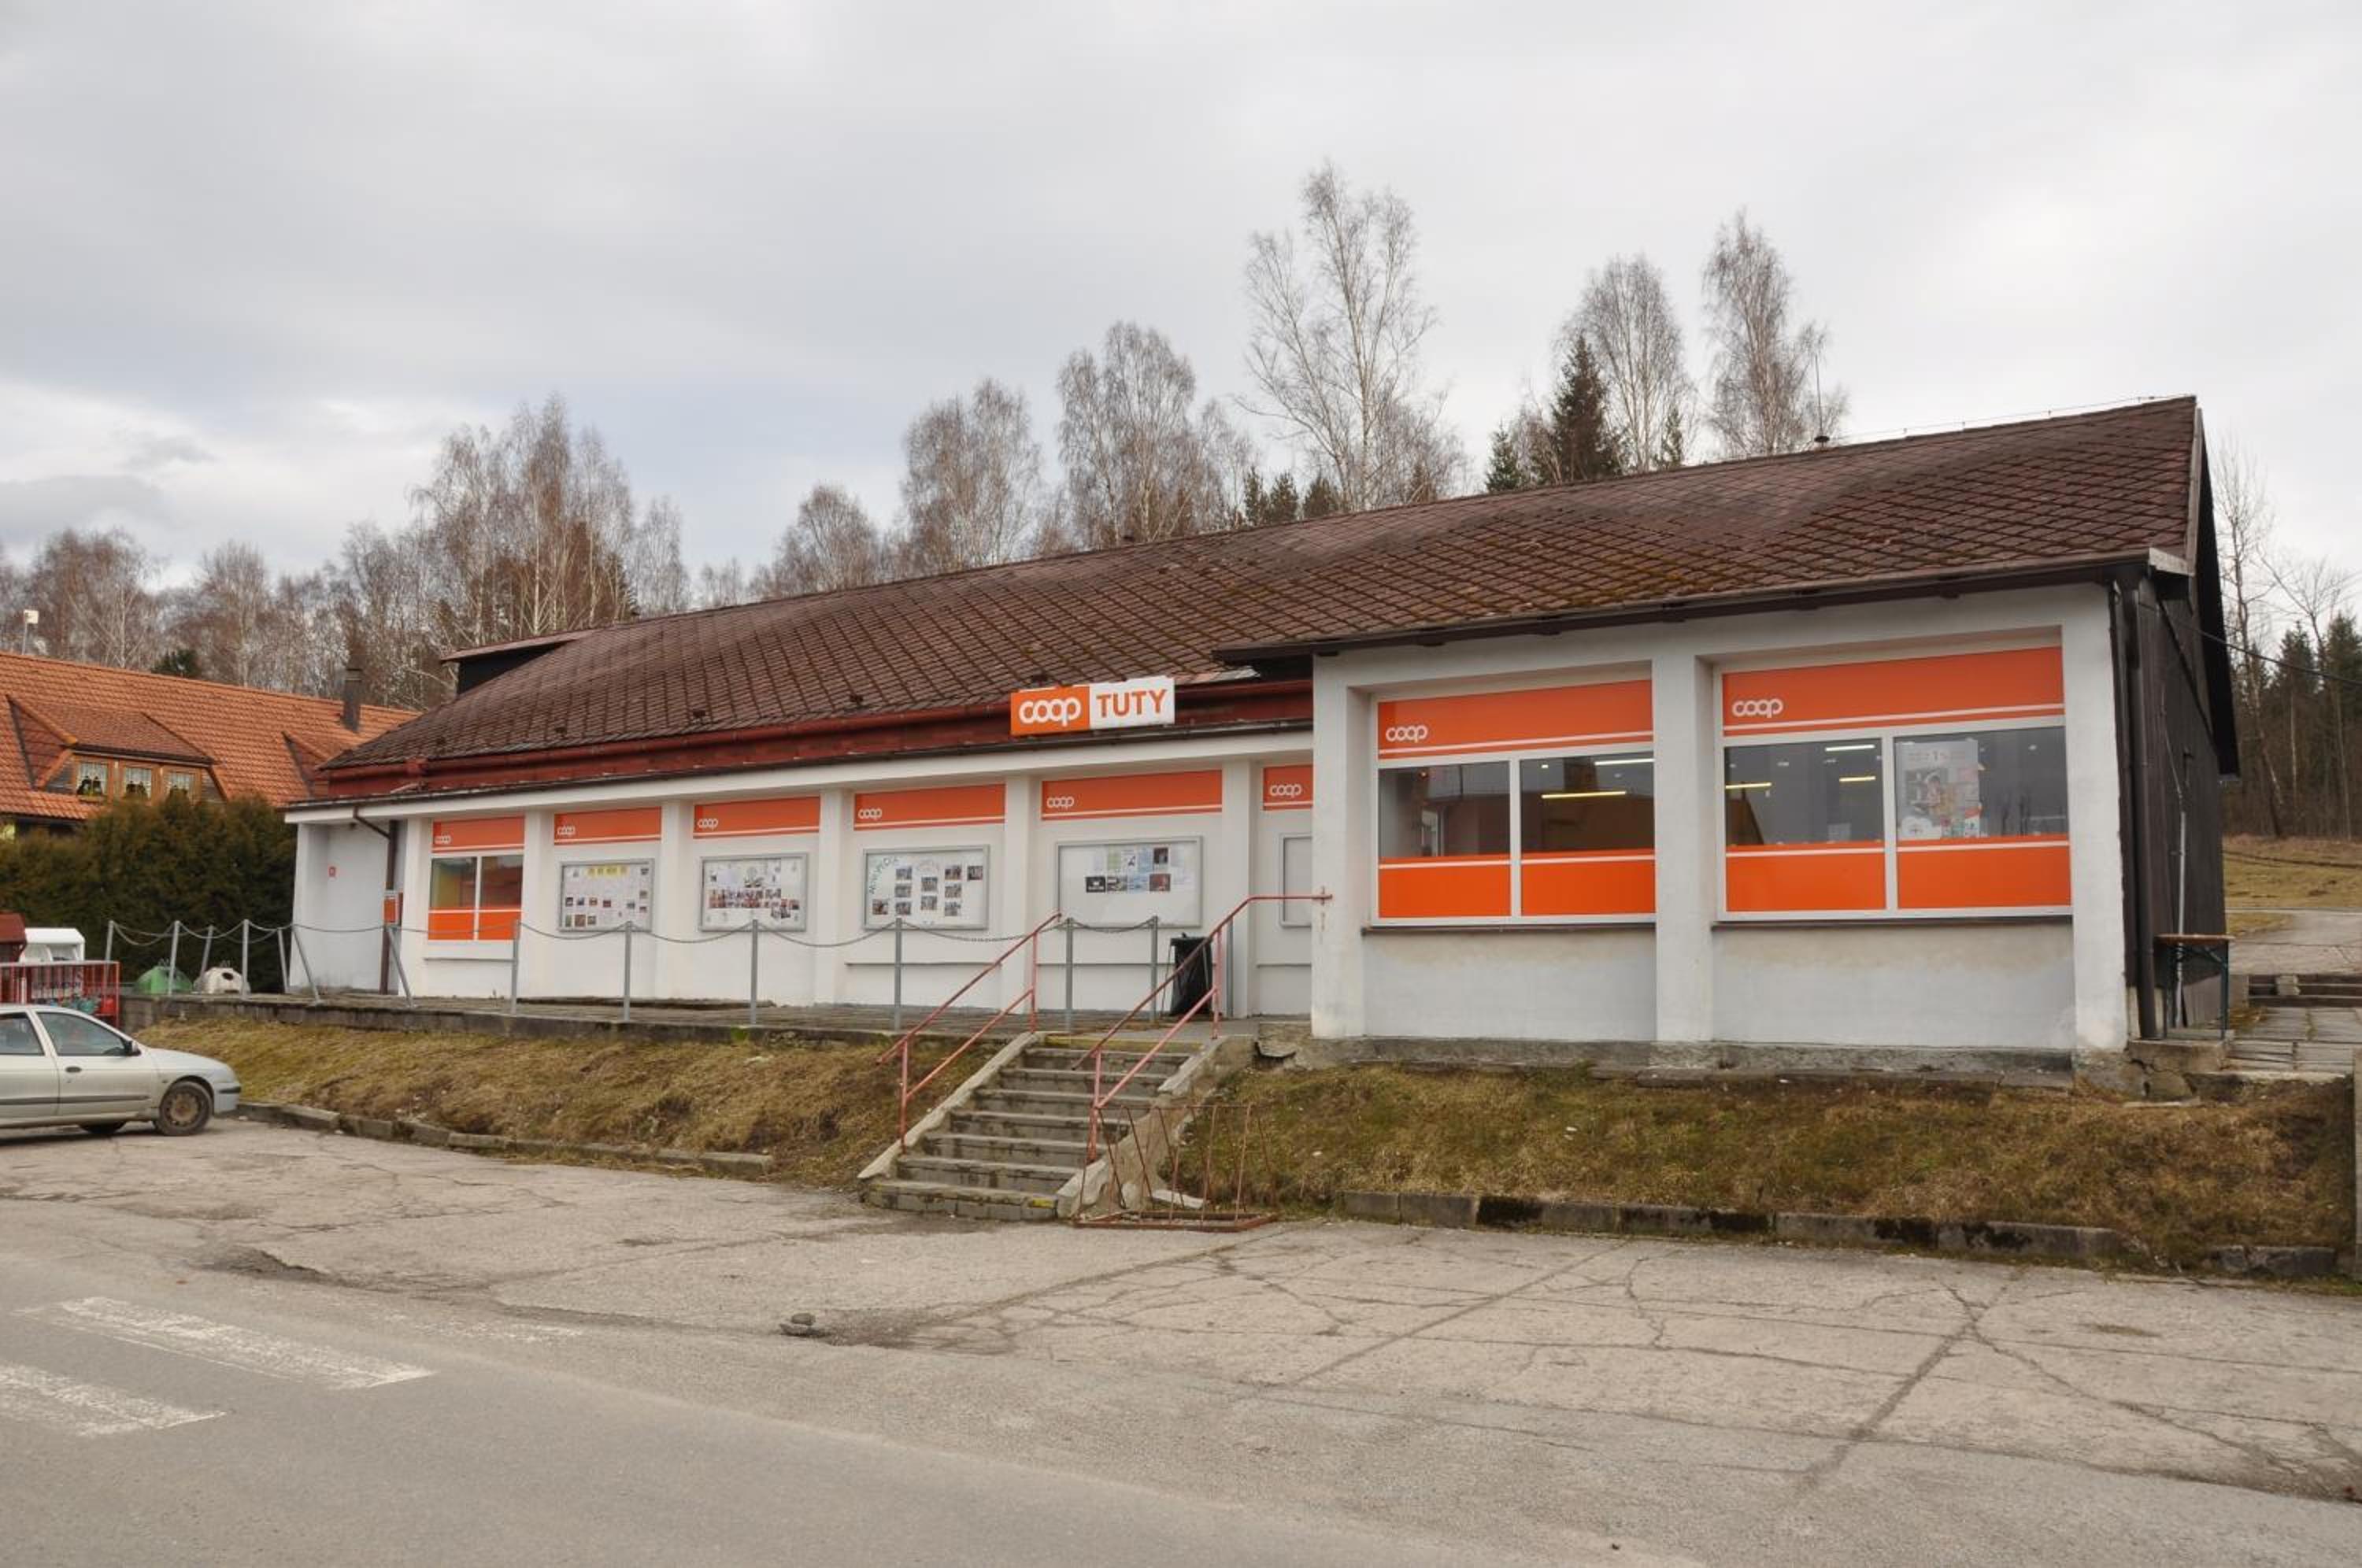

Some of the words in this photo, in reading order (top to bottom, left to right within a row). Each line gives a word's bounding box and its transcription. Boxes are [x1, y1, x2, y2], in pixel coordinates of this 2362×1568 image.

[1019, 697, 1081, 727] coop
[1097, 689, 1166, 718] TUTY
[1732, 698, 1783, 718] coop
[1386, 725, 1428, 744] coop
[1269, 783, 1301, 797] coop
[1047, 796, 1075, 809] coop
[857, 808, 882, 820] coop
[557, 824, 576, 836] coop
[698, 817, 719, 830] coop
